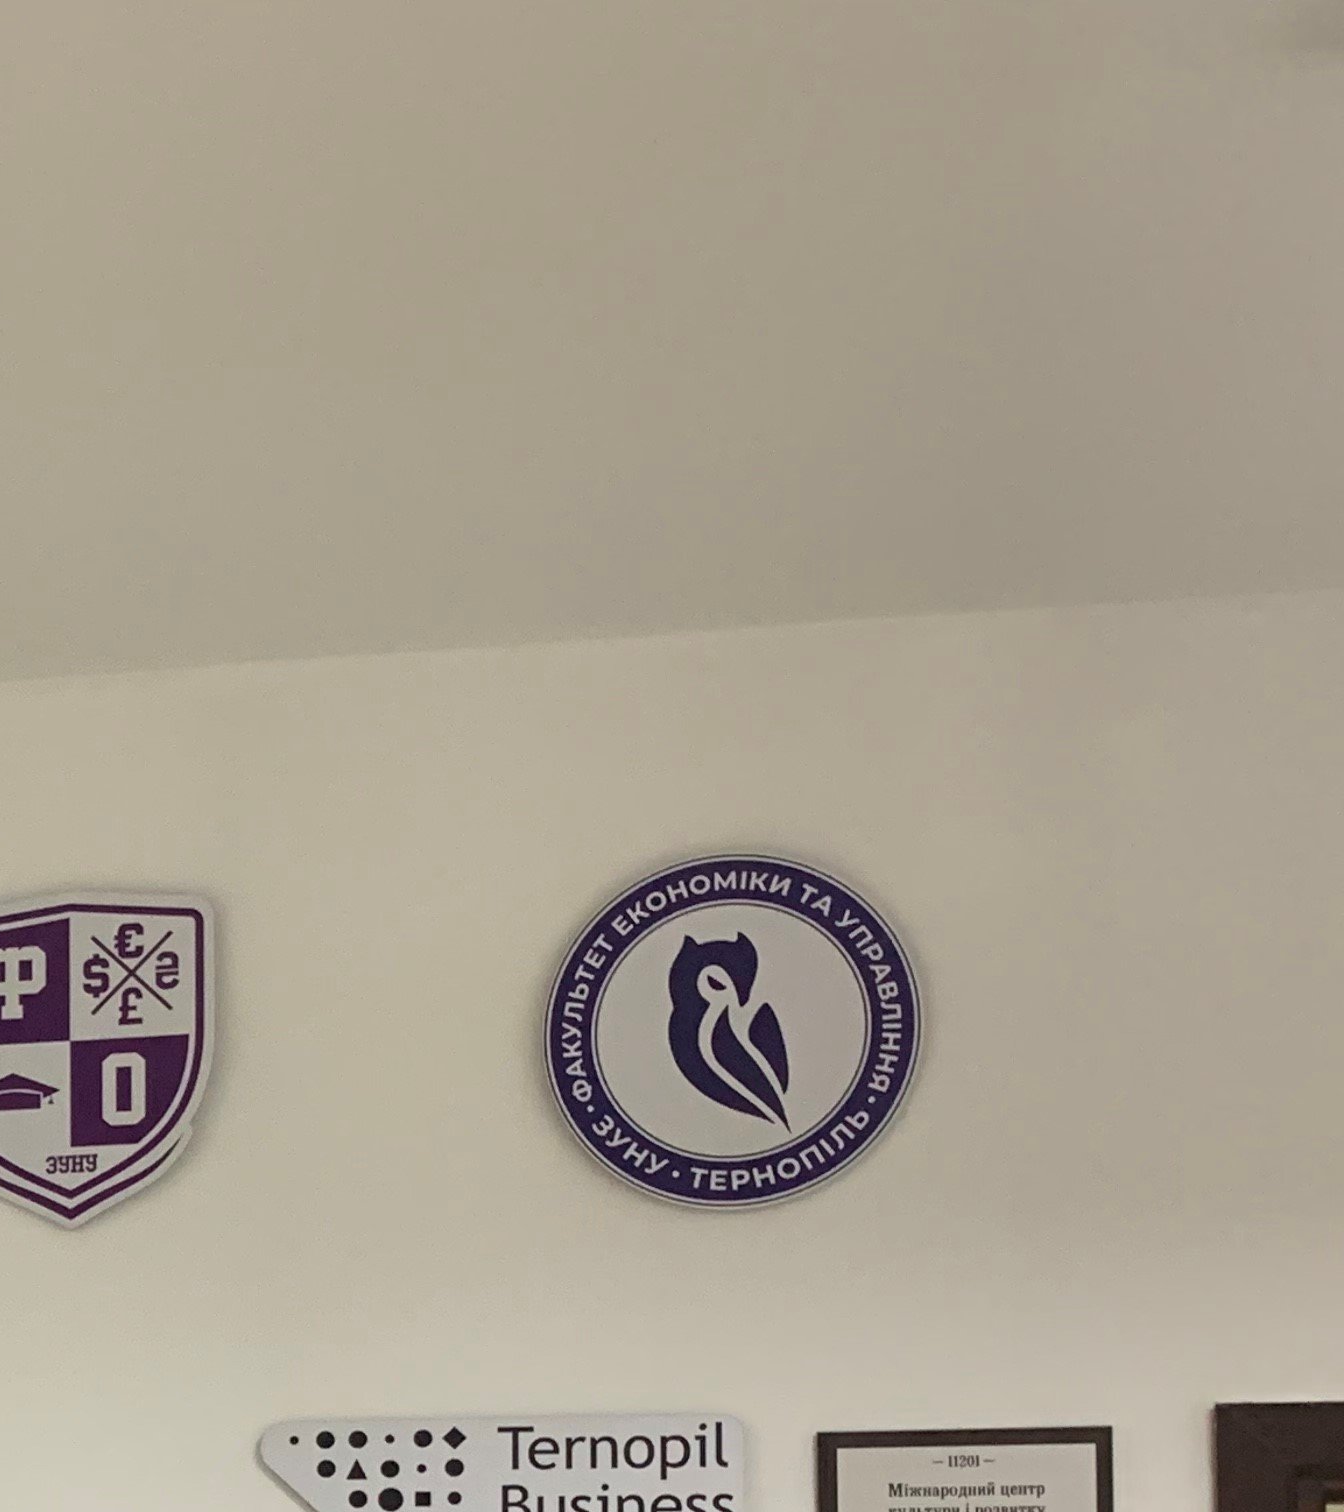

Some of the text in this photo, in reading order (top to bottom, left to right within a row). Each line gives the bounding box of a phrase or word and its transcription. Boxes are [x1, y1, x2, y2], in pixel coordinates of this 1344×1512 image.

[561, 870, 902, 1103] ФАКУЛЬТЕТ ЕКОНОМІКИ ТА УПРАВЛІННЯ
[45, 1154, 98, 1174] ЗУНУ
[591, 1114, 670, 1176] ЗУНУ
[689, 1109, 872, 1191] ТЕРНОПІЛЬ
[497, 1422, 729, 1480] Ternopil
[888, 1482, 1046, 1500] Міжнародний центр
